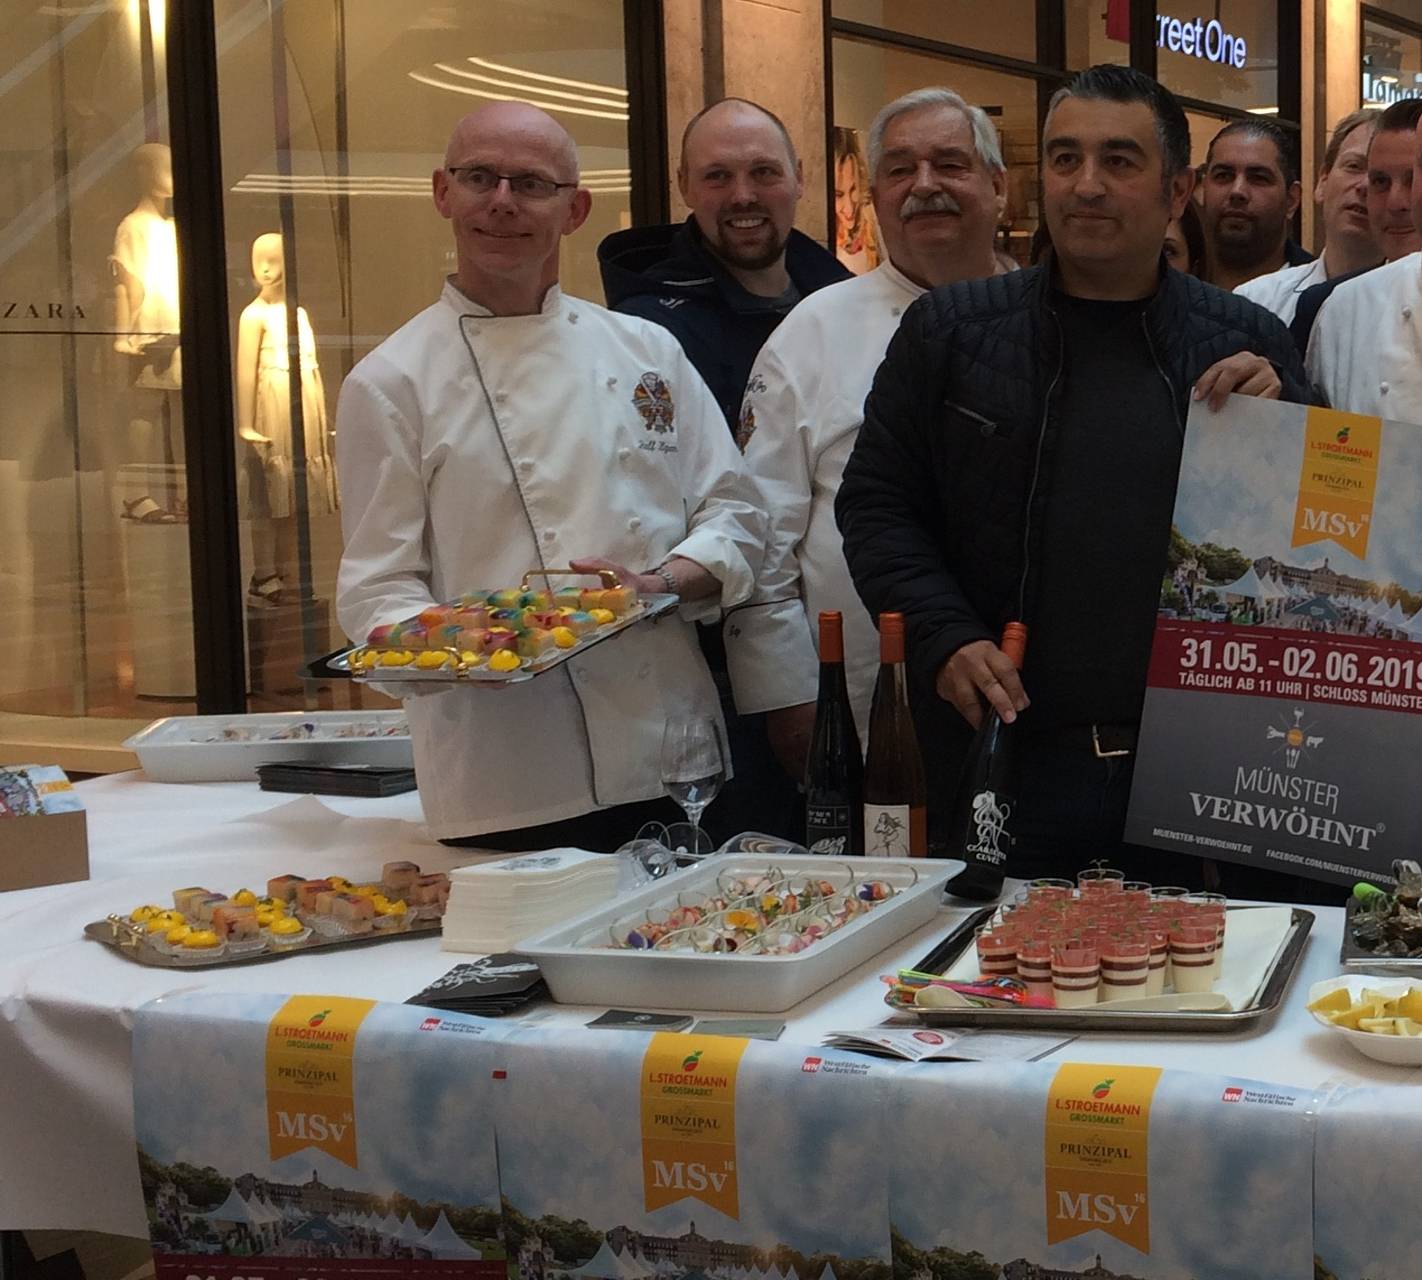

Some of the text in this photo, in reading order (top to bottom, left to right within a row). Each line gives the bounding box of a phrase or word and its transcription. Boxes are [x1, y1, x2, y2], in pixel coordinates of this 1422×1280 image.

[1156, 14, 1246, 68] reet One
[3, 303, 86, 318] ZARA
[1311, 472, 1364, 489] PRINZIPAL
[1178, 671, 1232, 689] TÄGLICH
[1236, 679, 1254, 691] AB
[1260, 681, 1271, 692] 11
[1276, 682, 1302, 695] UHR
[1313, 684, 1367, 703] SCHLOSS
[1234, 766, 1339, 814] MÜNSTER
[278, 1066, 338, 1082] PRINZIPAL
[654, 1114, 720, 1129] PRINZIPAL
[1060, 1143, 1132, 1159] PRINZIPAL
